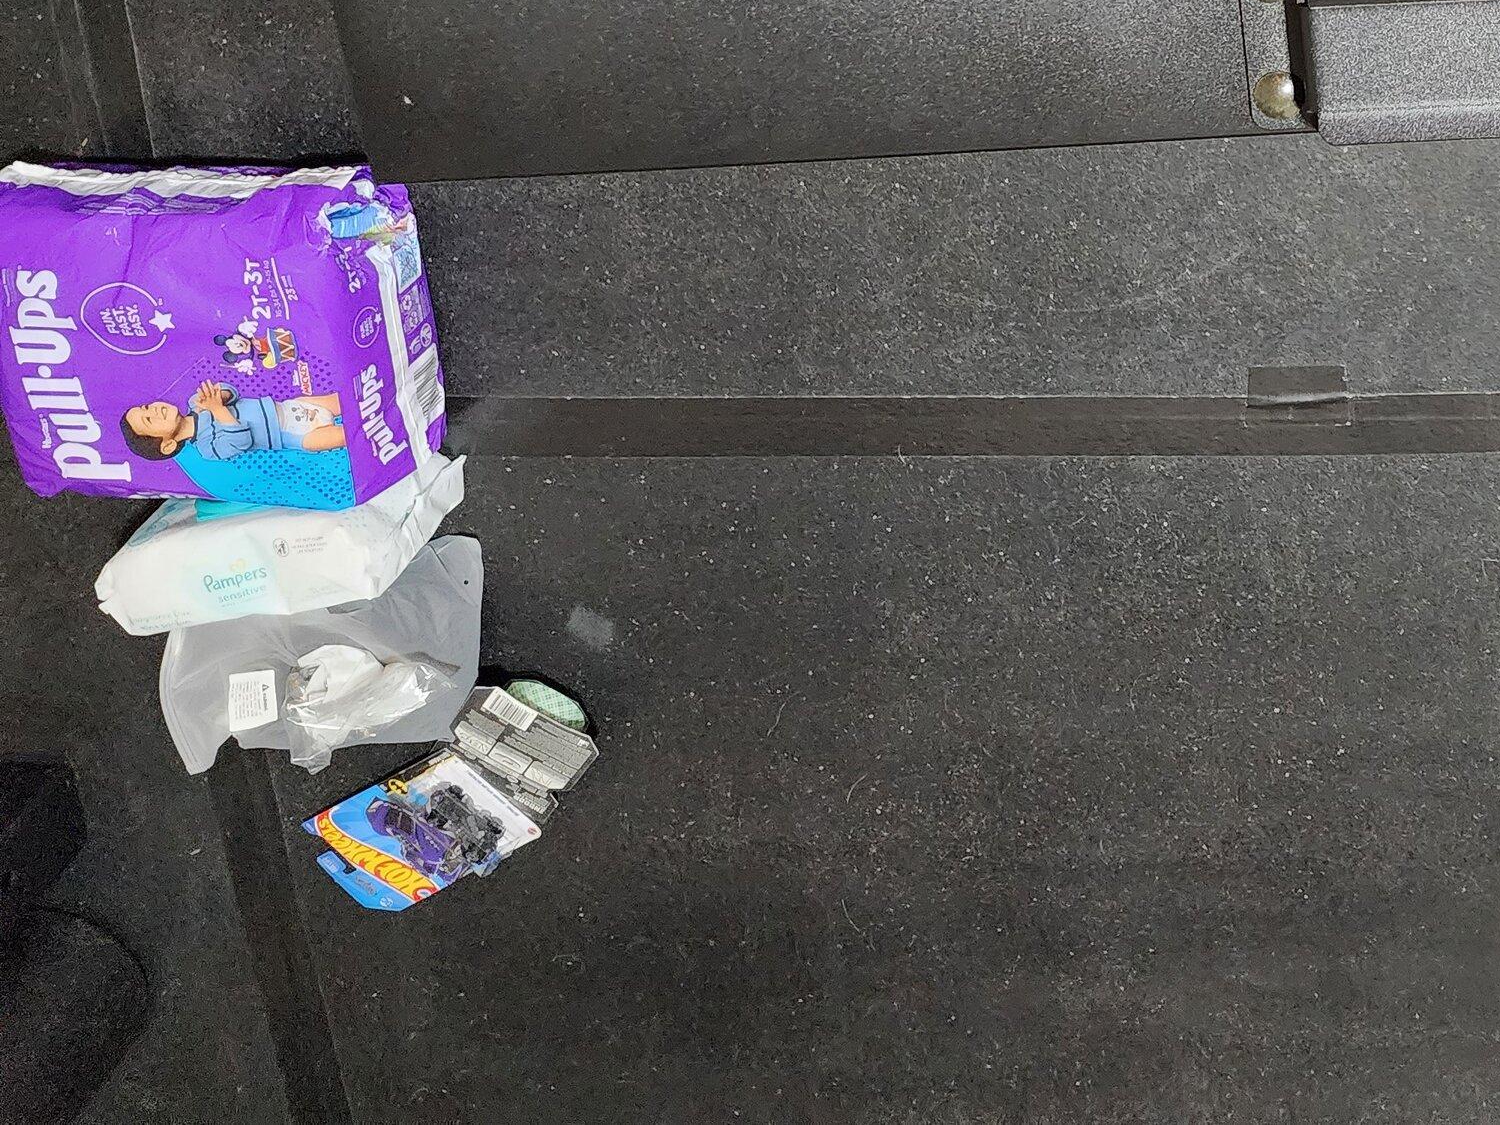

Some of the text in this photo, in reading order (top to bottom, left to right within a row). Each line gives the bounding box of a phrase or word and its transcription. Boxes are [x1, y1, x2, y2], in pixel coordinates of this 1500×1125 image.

[244, 257, 271, 320] 2T-3T
[203, 566, 268, 593] Pampers
[217, 584, 267, 603] sensitive
